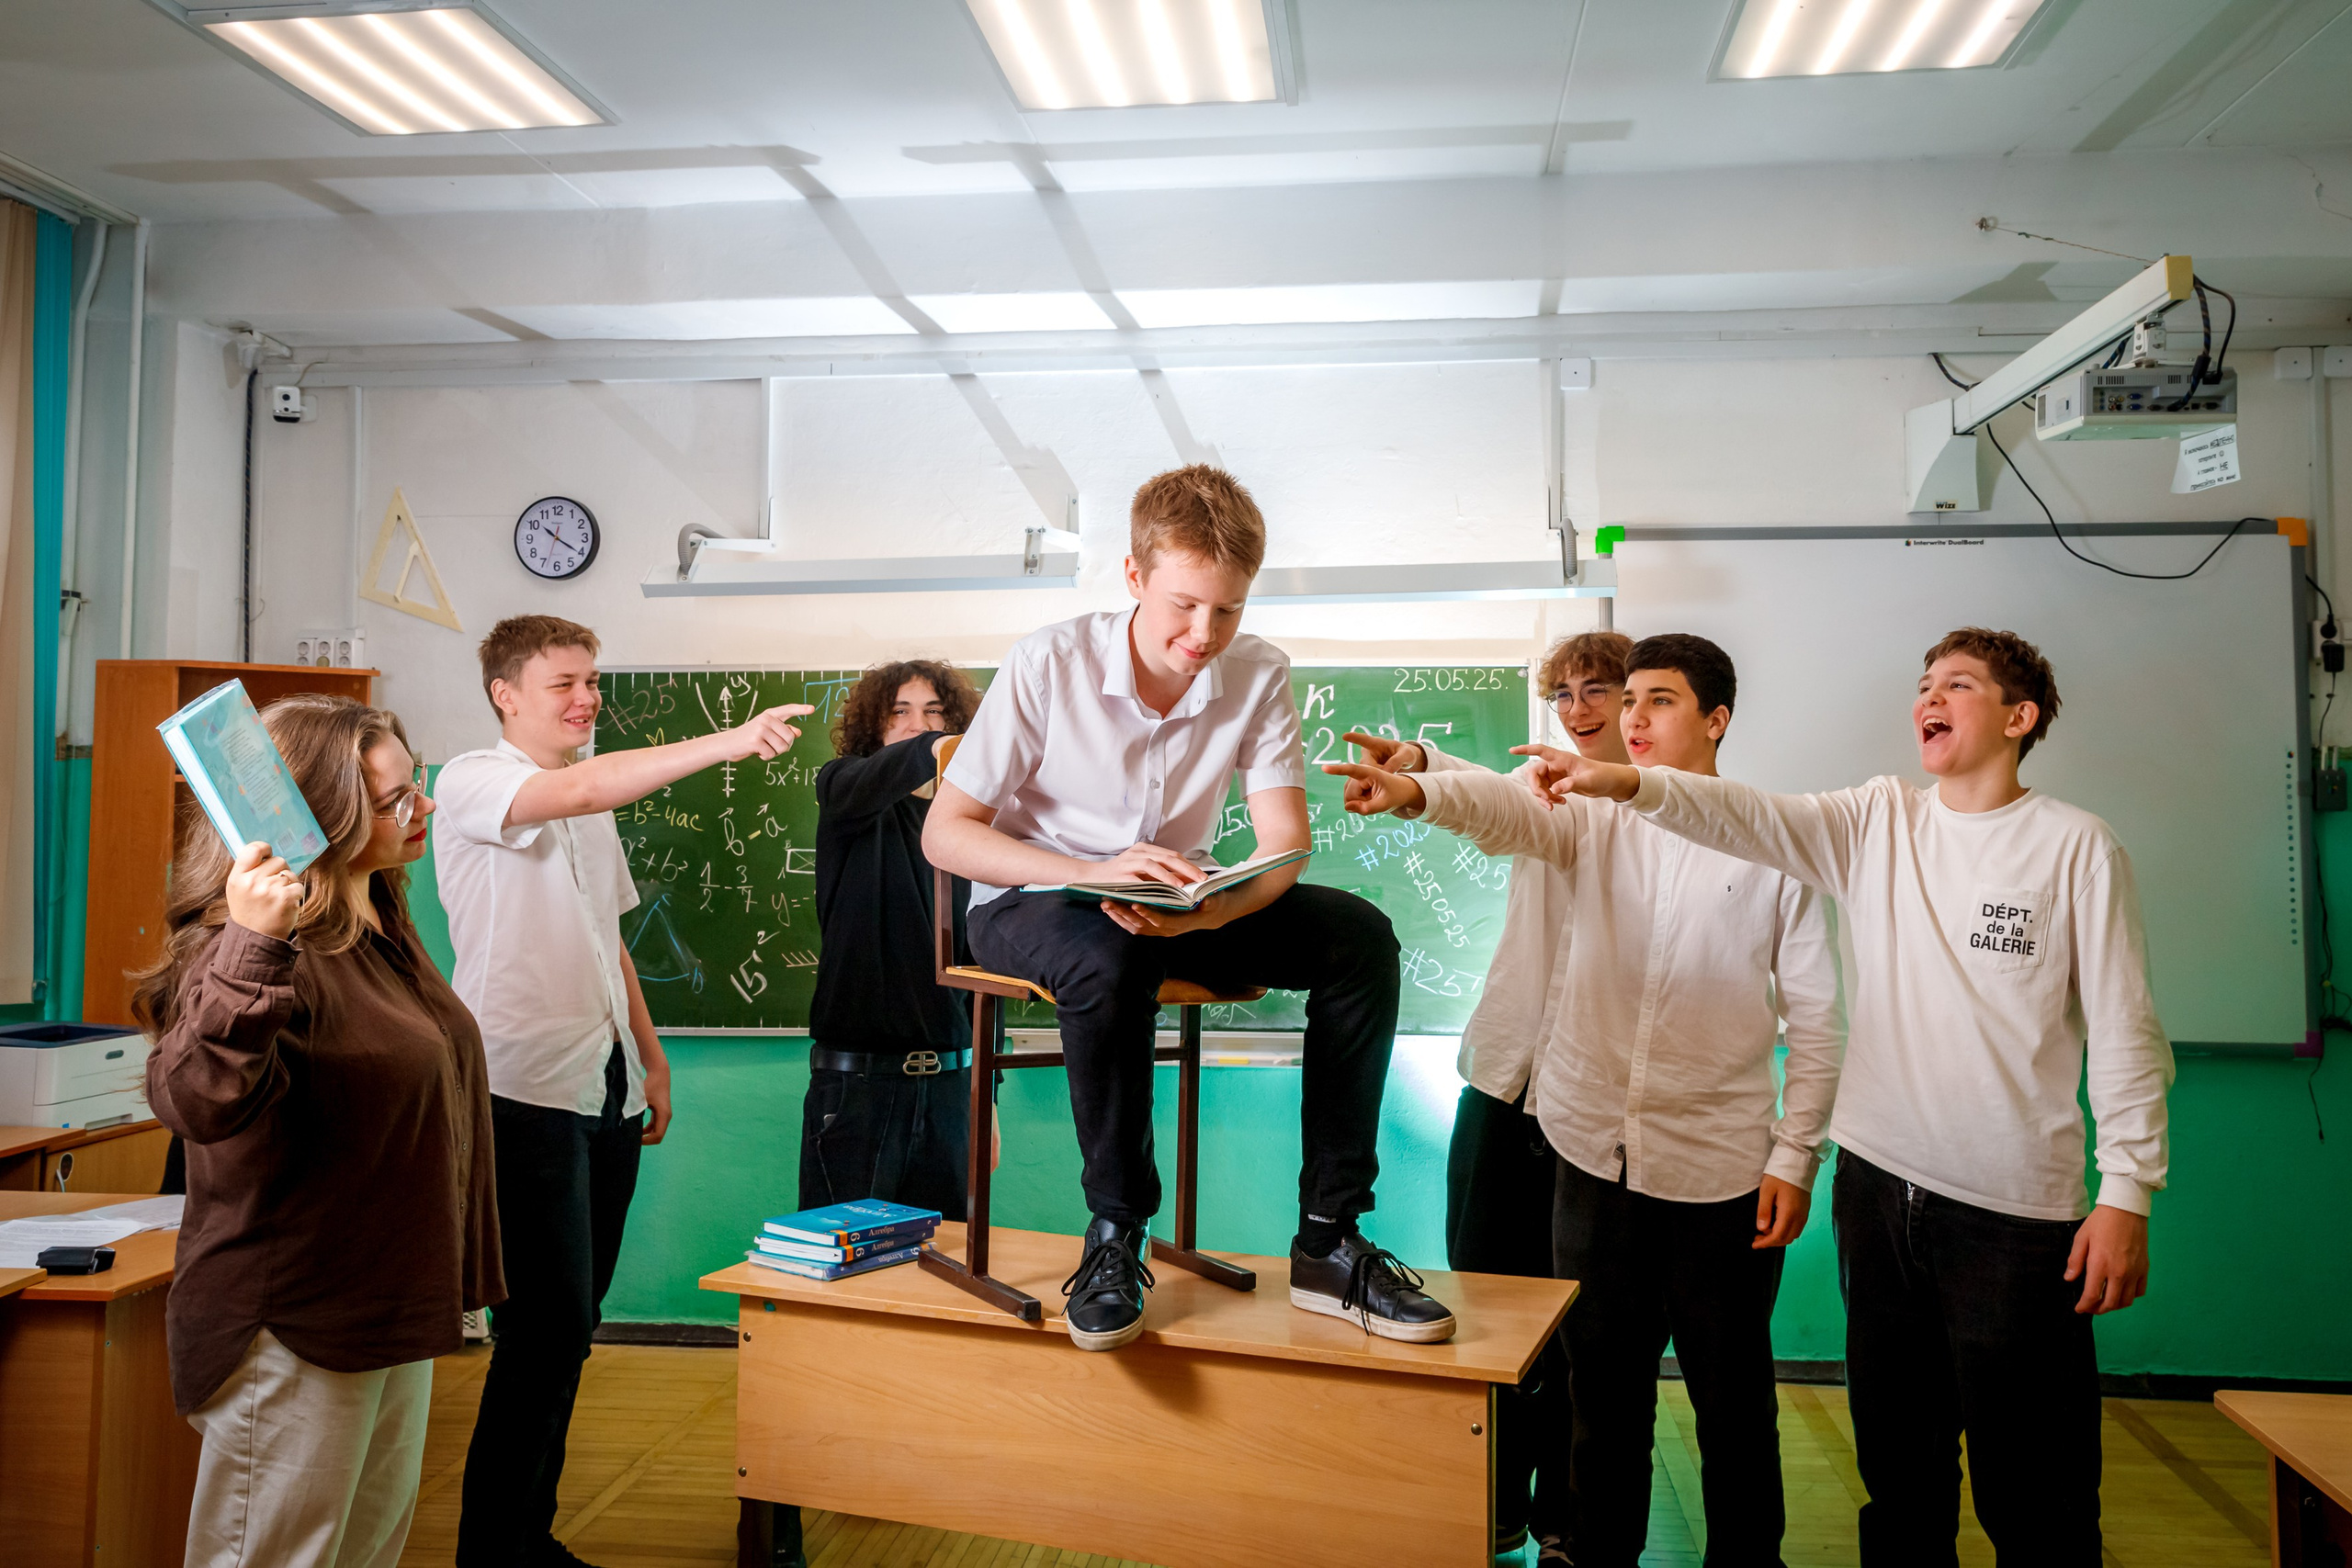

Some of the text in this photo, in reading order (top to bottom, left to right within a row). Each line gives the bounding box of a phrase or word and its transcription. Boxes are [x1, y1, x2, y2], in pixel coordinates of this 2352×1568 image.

[539, 509, 549, 520] 11
[552, 505, 563, 515] 12
[528, 520, 540, 530] 10
[578, 519, 585, 529] 2
[526, 534, 533, 544] 9
[581, 533, 589, 543] 3
[530, 547, 537, 558] 8
[578, 547, 584, 558] 4
[540, 558, 547, 568] 7
[553, 561, 560, 571] 6
[567, 557, 574, 568] 5
[1982, 903, 2033, 923] DÉPT.
[1986, 920, 2024, 937] de la
[1970, 932, 2036, 955] GALERIE
[868, 1226, 895, 1236] Алгебра
[872, 1240, 895, 1251] Алгебра
